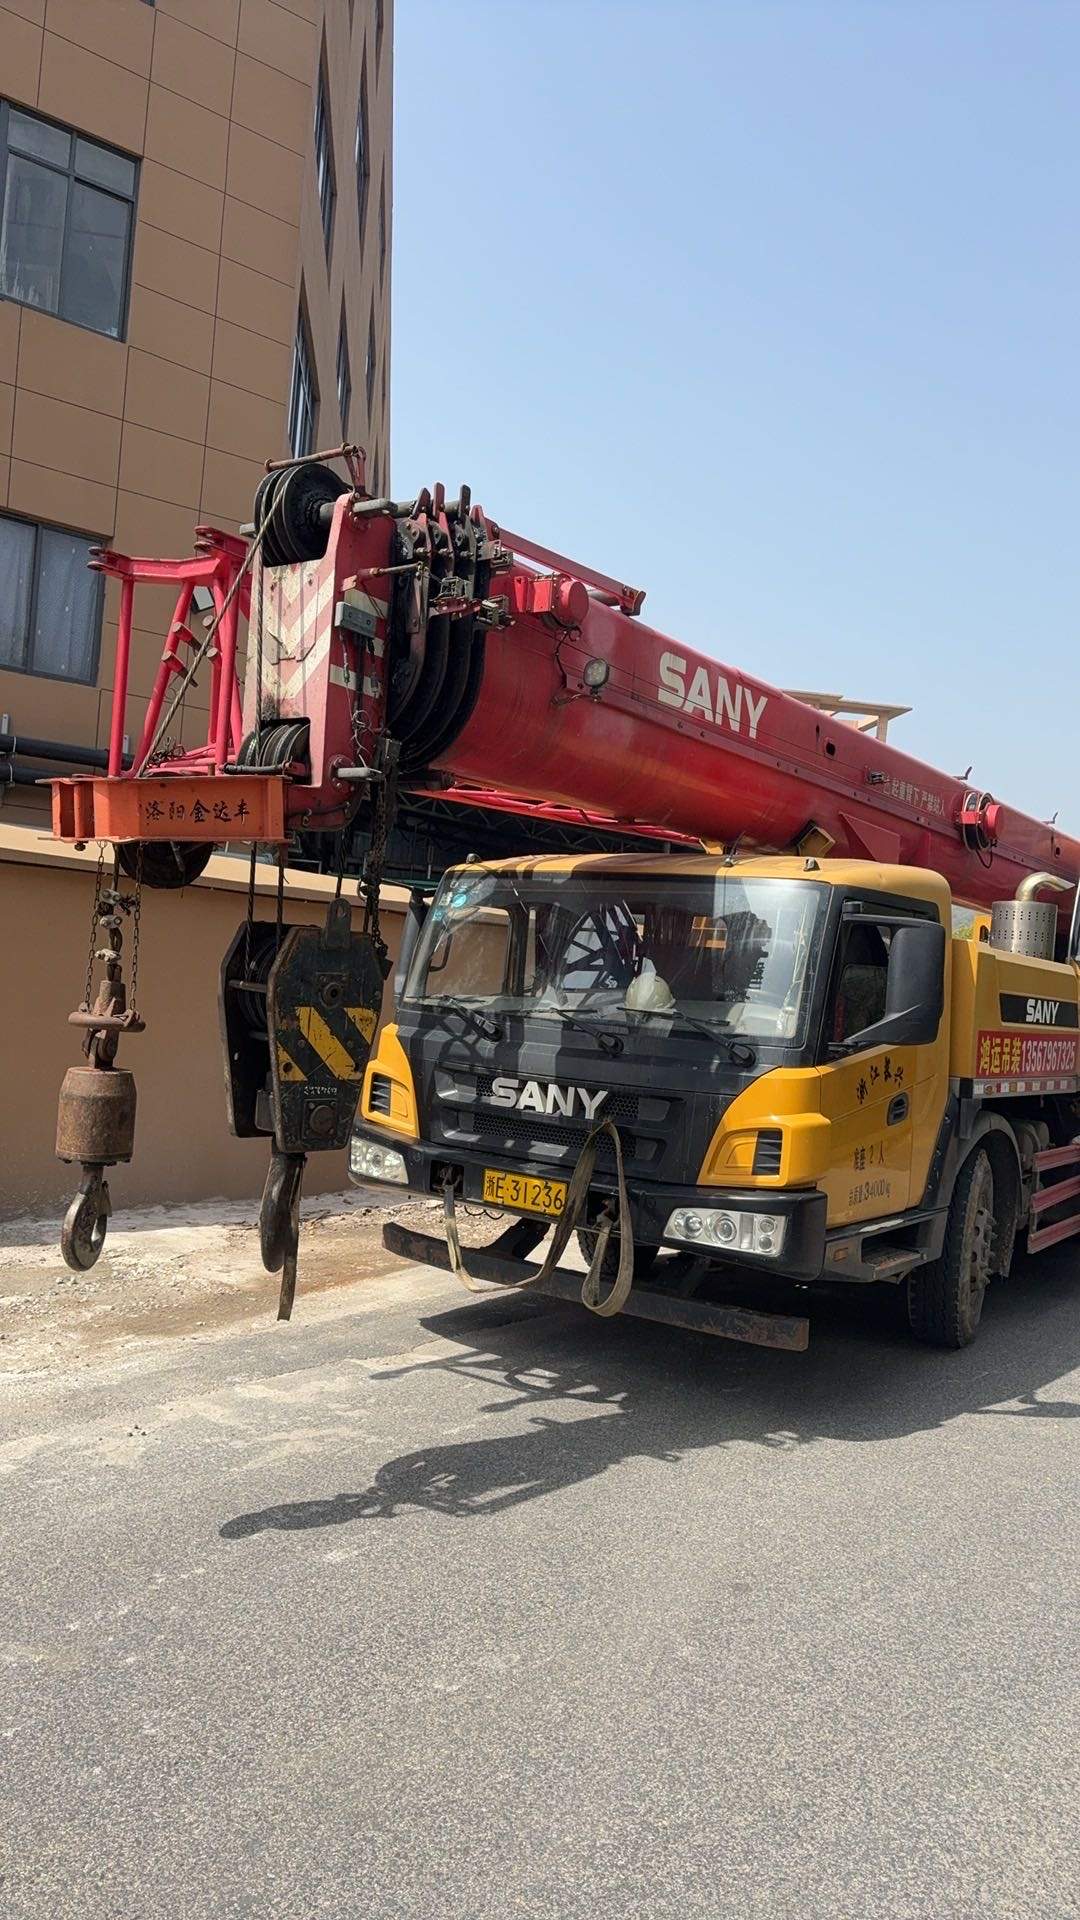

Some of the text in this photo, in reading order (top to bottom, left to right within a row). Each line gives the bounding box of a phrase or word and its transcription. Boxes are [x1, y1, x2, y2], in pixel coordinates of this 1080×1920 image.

[657, 650, 769, 740] SANY
[1025, 998, 1060, 1024] SANY
[490, 1076, 609, 1120] SANY
